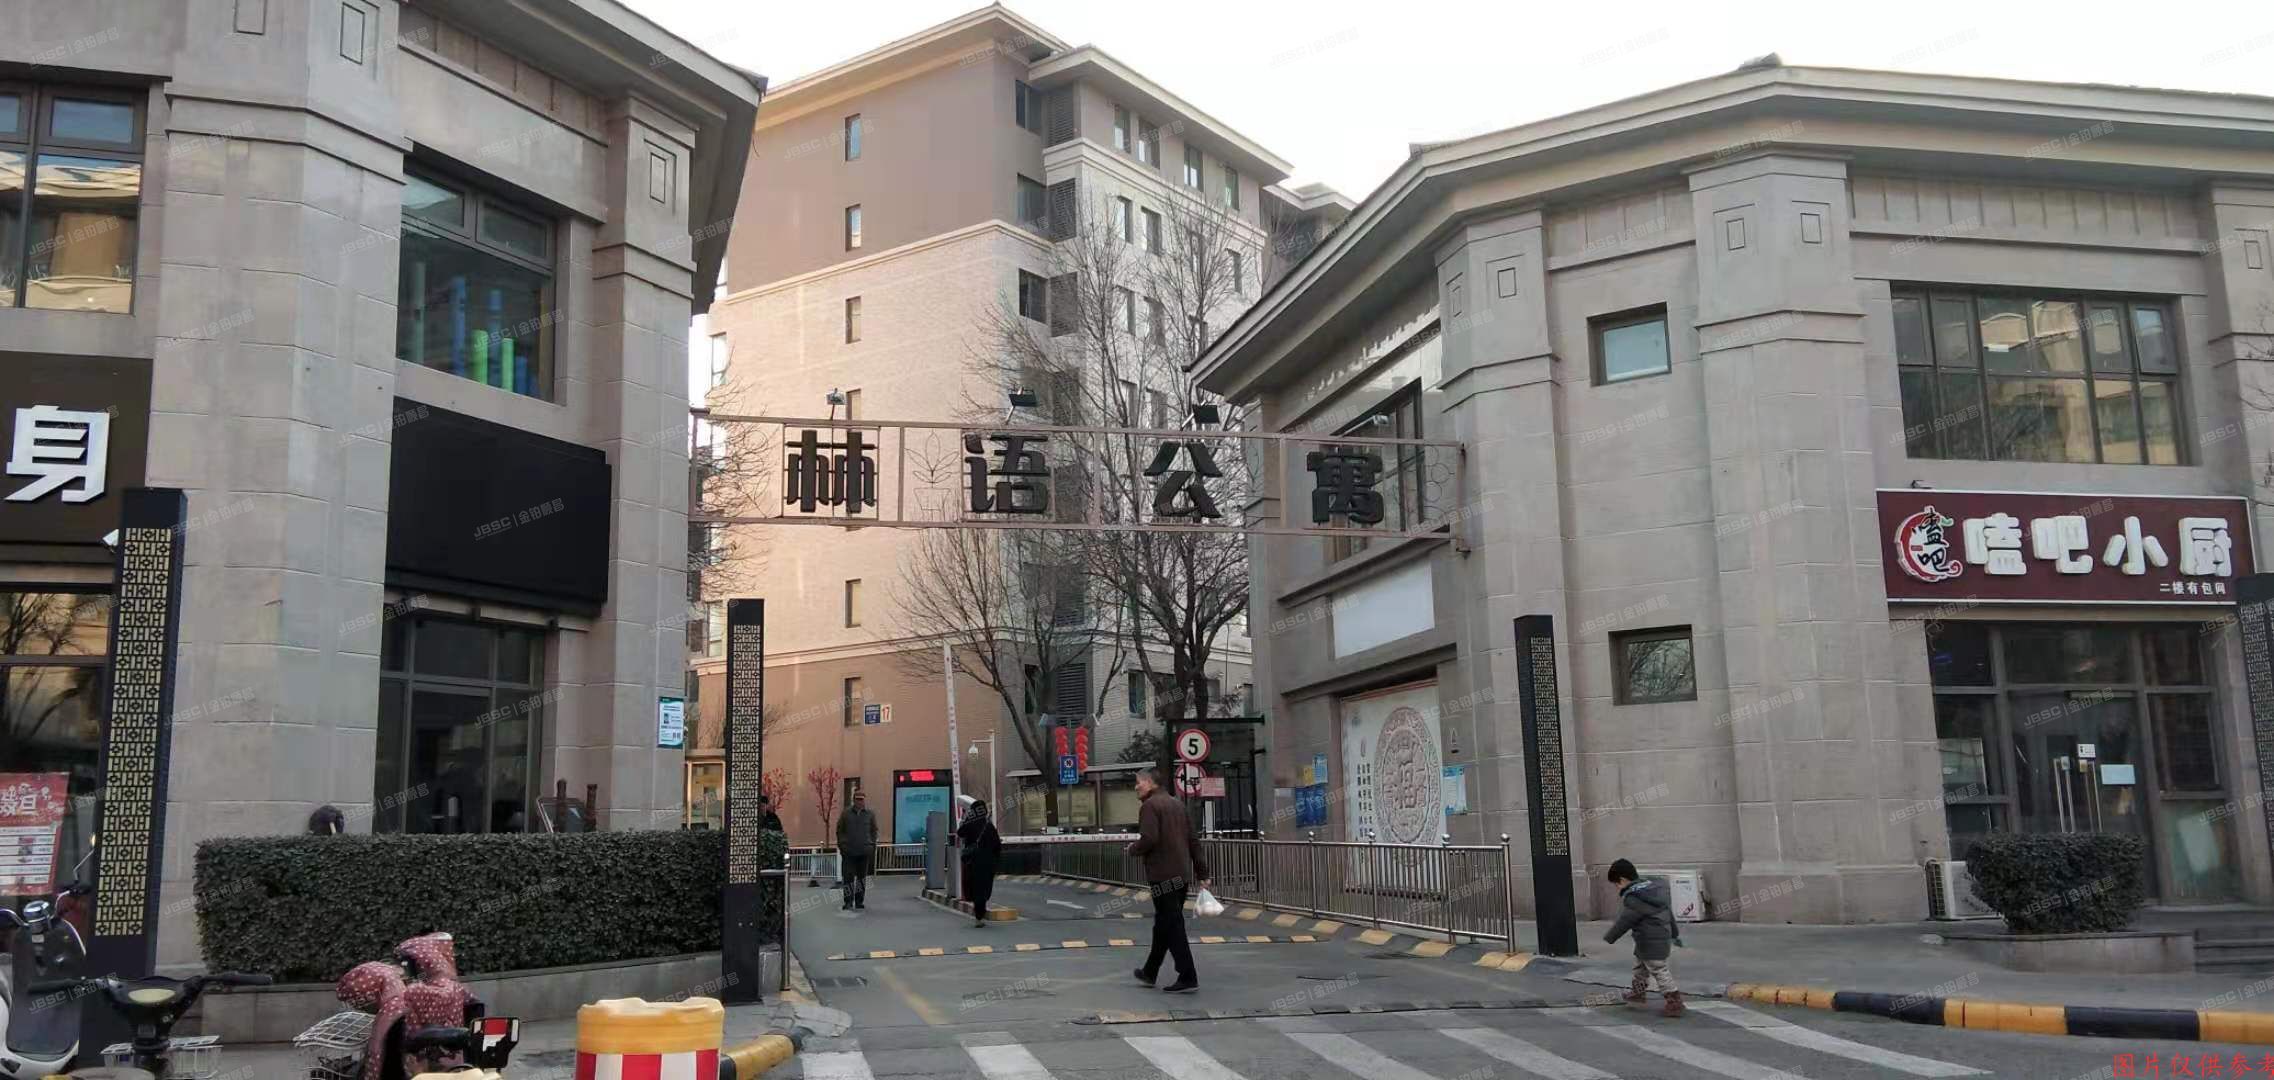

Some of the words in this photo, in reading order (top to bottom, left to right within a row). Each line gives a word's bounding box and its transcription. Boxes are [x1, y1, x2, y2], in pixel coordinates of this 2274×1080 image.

[4, 405, 110, 502] 身
[786, 430, 1384, 525] 林语公寓
[1963, 512, 2232, 577] 嗑吧小厨
[1188, 738, 1199, 756] 5
